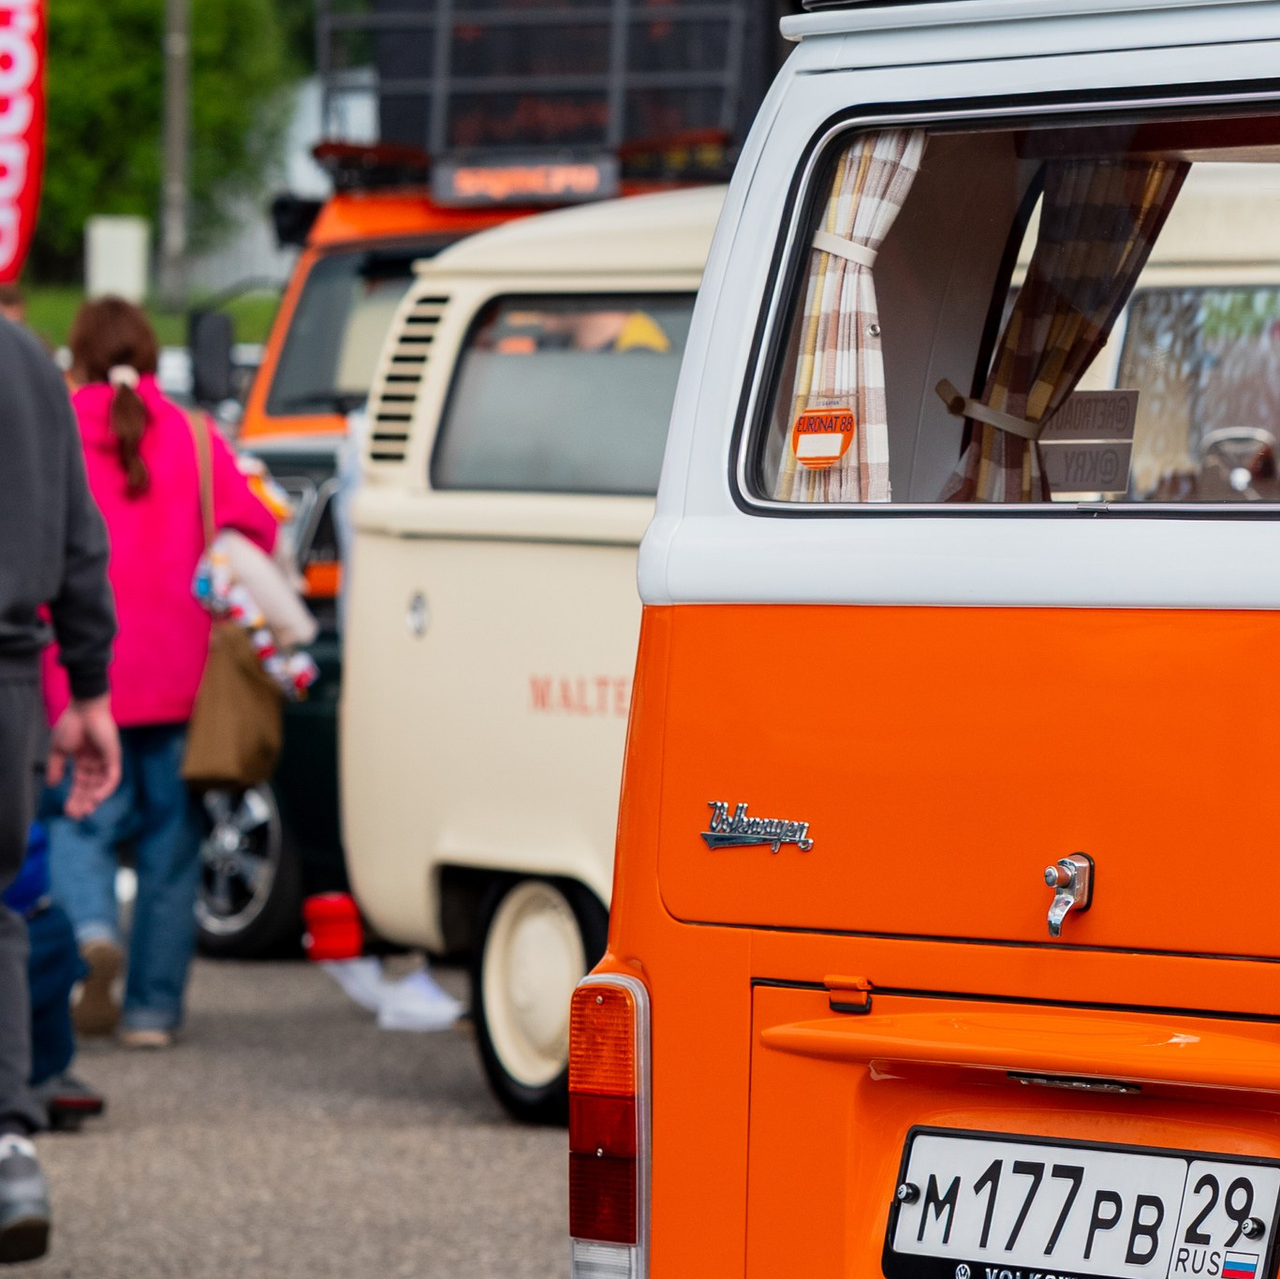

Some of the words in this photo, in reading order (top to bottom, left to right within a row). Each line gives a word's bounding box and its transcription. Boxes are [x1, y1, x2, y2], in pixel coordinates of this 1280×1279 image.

[797, 416, 840, 432] EURONAT
[840, 416, 853, 432] 88
[1184, 1174, 1254, 1248] 29
[1174, 1247, 1221, 1276] RUS
